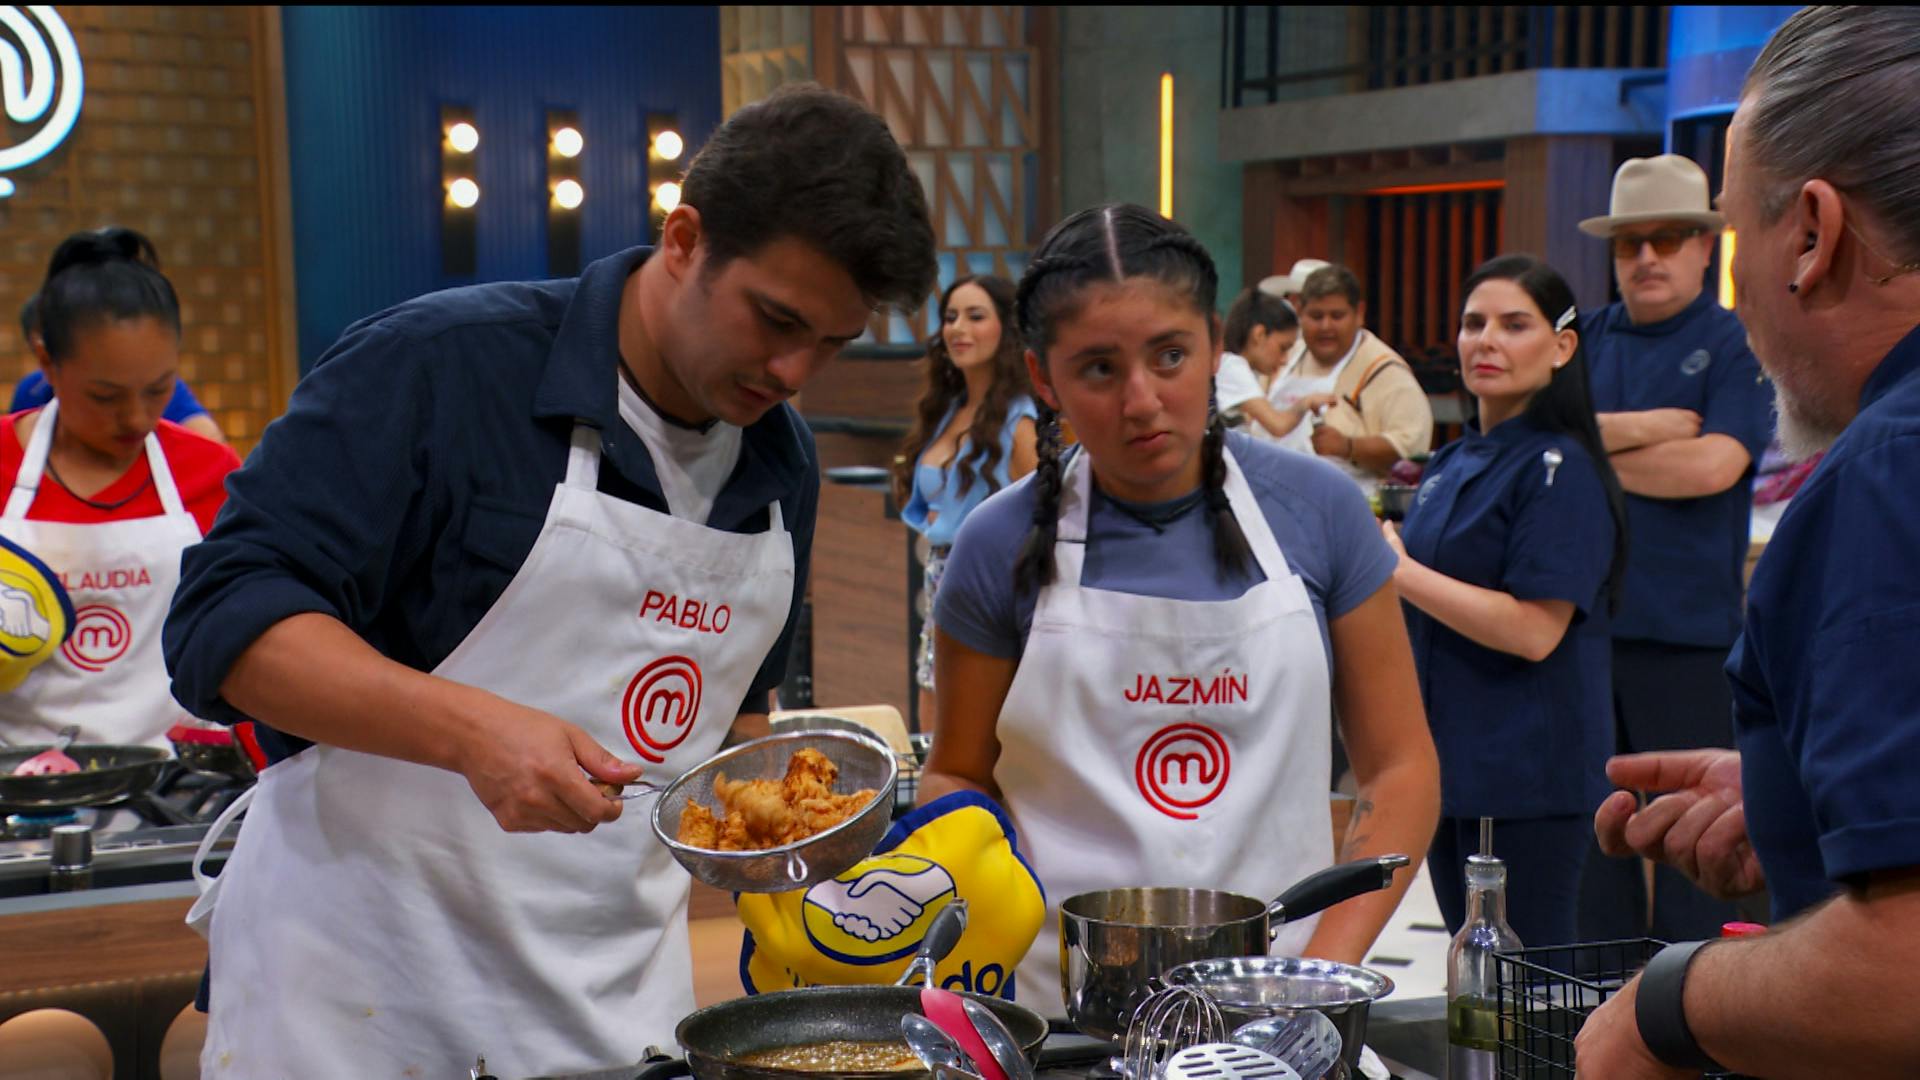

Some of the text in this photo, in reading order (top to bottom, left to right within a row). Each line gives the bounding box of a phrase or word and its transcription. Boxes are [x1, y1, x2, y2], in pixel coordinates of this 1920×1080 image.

[54, 565, 151, 591] LAUDIA
[639, 589, 731, 634] PABLO
[1124, 667, 1248, 705] JAZMÍN
